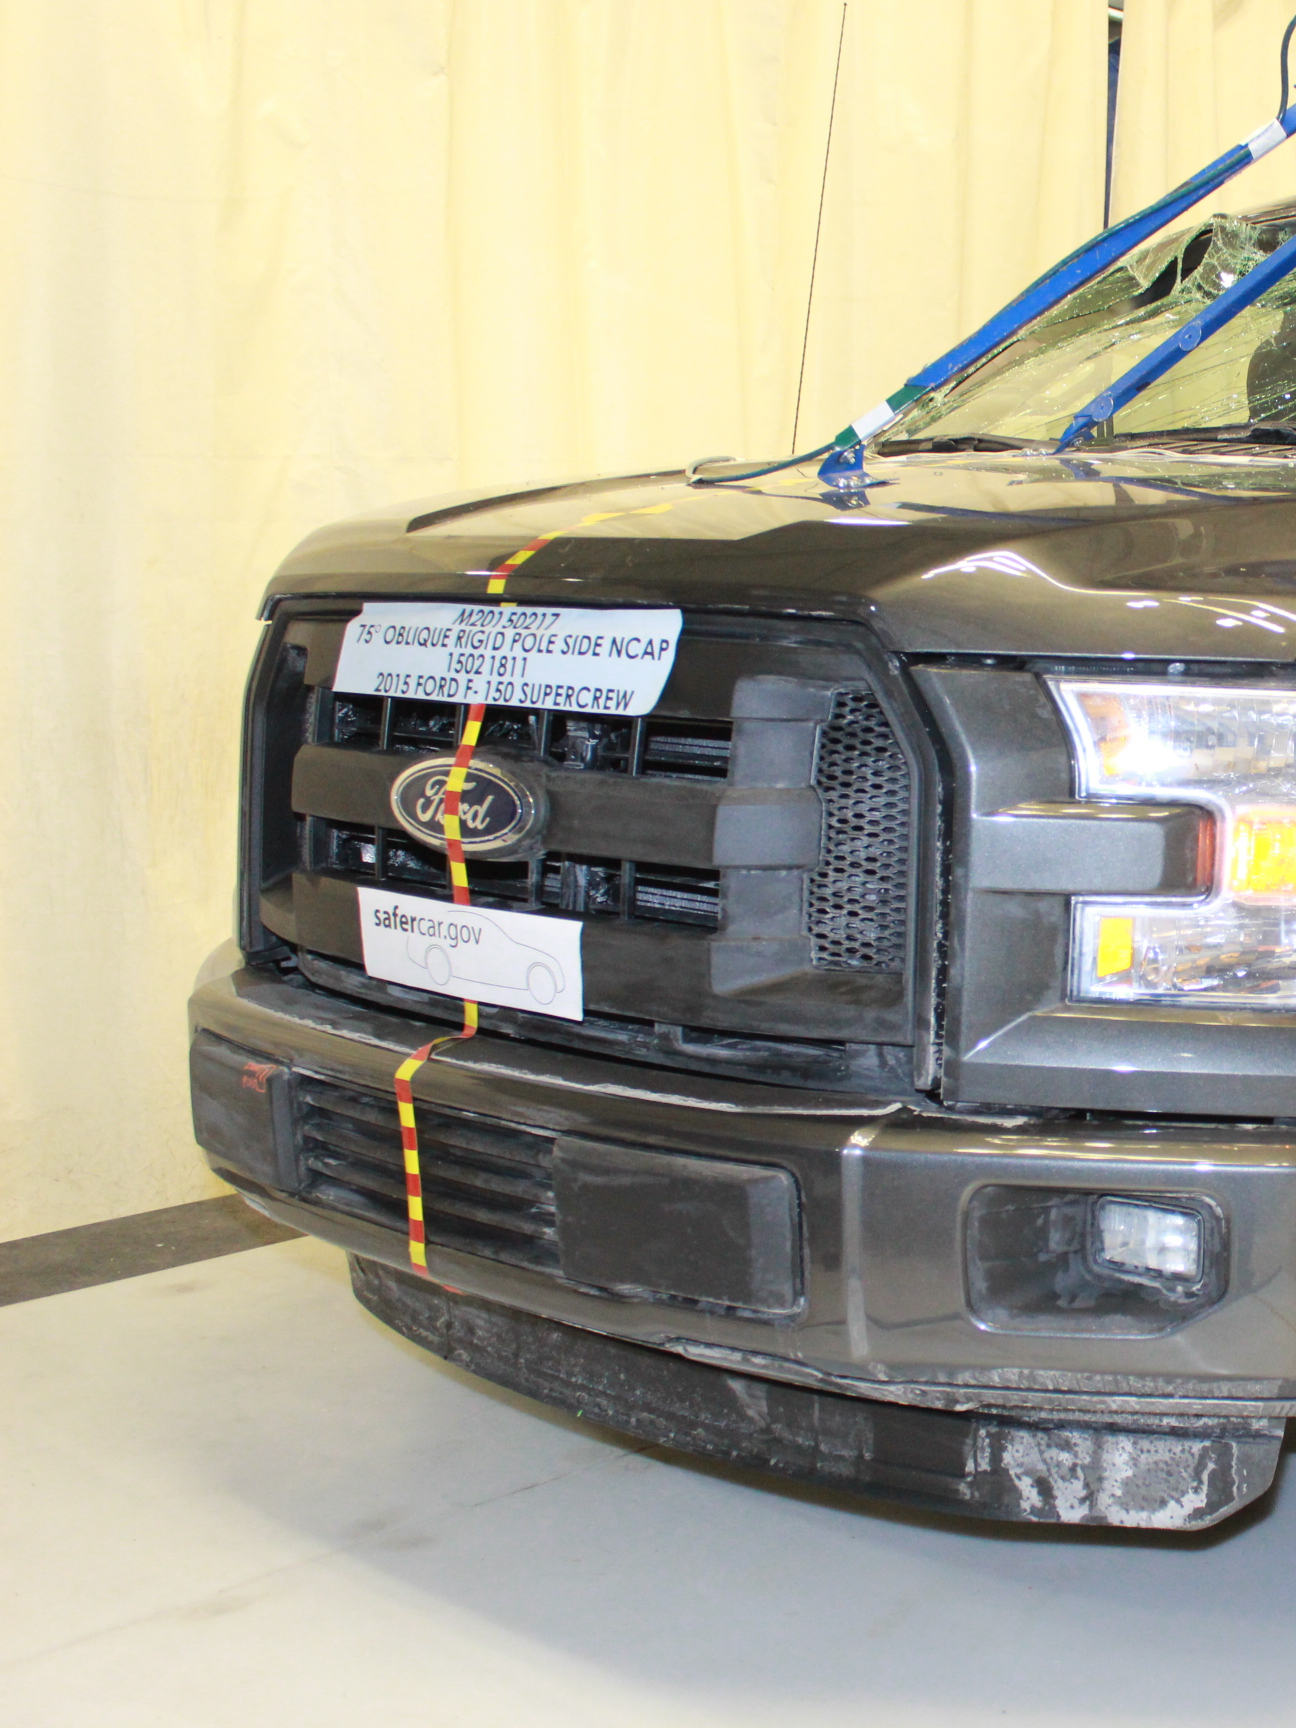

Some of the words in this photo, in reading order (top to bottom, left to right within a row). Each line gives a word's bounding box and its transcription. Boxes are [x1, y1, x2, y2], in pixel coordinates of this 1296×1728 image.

[452, 608, 561, 631] M20150217
[356, 624, 382, 645] 75°
[384, 626, 451, 649] OBLIQUE
[454, 629, 505, 652] RIGID
[510, 632, 557, 655] POLE
[561, 634, 603, 657] SIDE
[608, 637, 670, 661] NCAP
[447, 652, 528, 678] 15021811
[374, 672, 411, 694] 2015
[414, 676, 460, 699] FORD
[464, 679, 515, 704] F-150
[518, 683, 635, 712] SUPERCREW
[416, 775, 494, 830] Frd
[374, 905, 482, 948] safercar.gov
